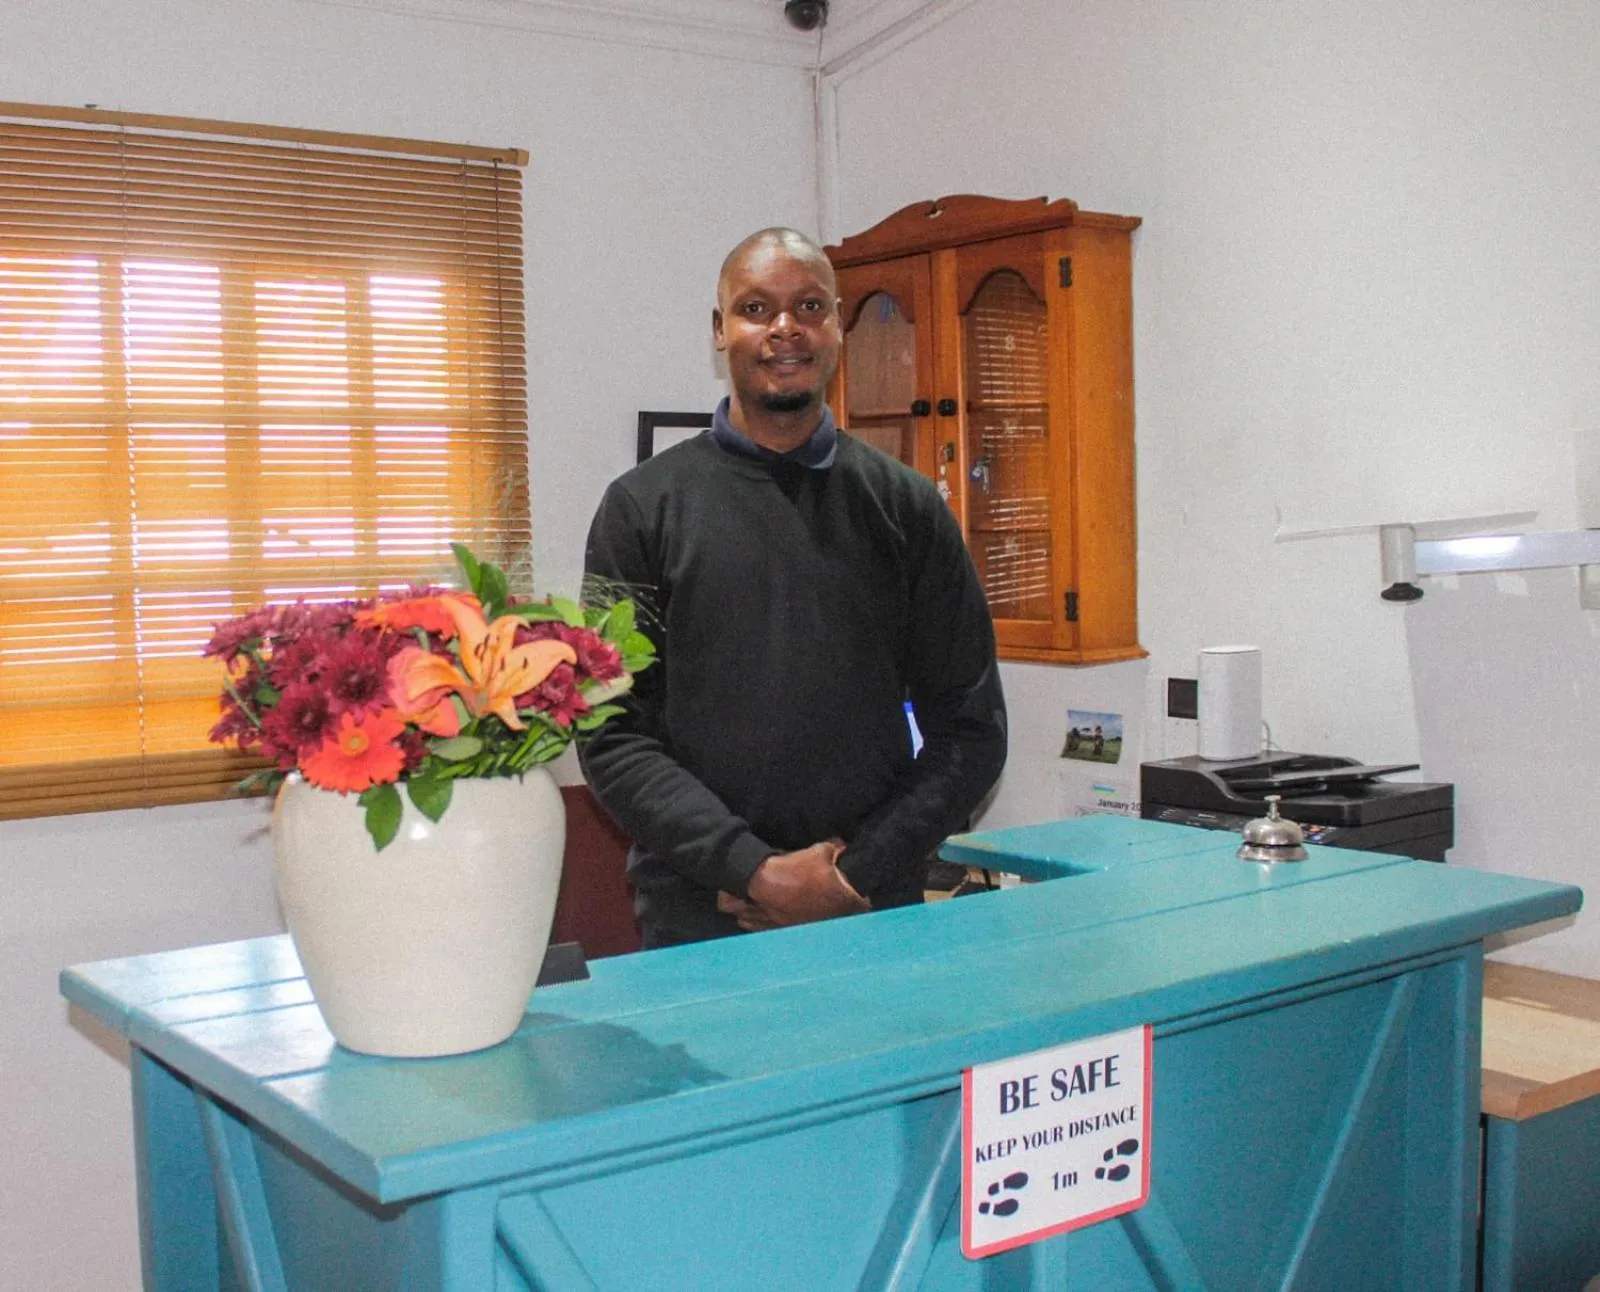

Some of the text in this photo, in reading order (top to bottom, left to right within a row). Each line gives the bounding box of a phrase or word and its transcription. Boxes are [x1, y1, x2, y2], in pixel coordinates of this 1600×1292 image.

[1098, 798, 1128, 812] January
[1000, 1053, 1121, 1115] BE SAFE
[976, 1105, 1138, 1163] KEEP YOUR DISTANCE
[1051, 1171, 1078, 1191] 1m
